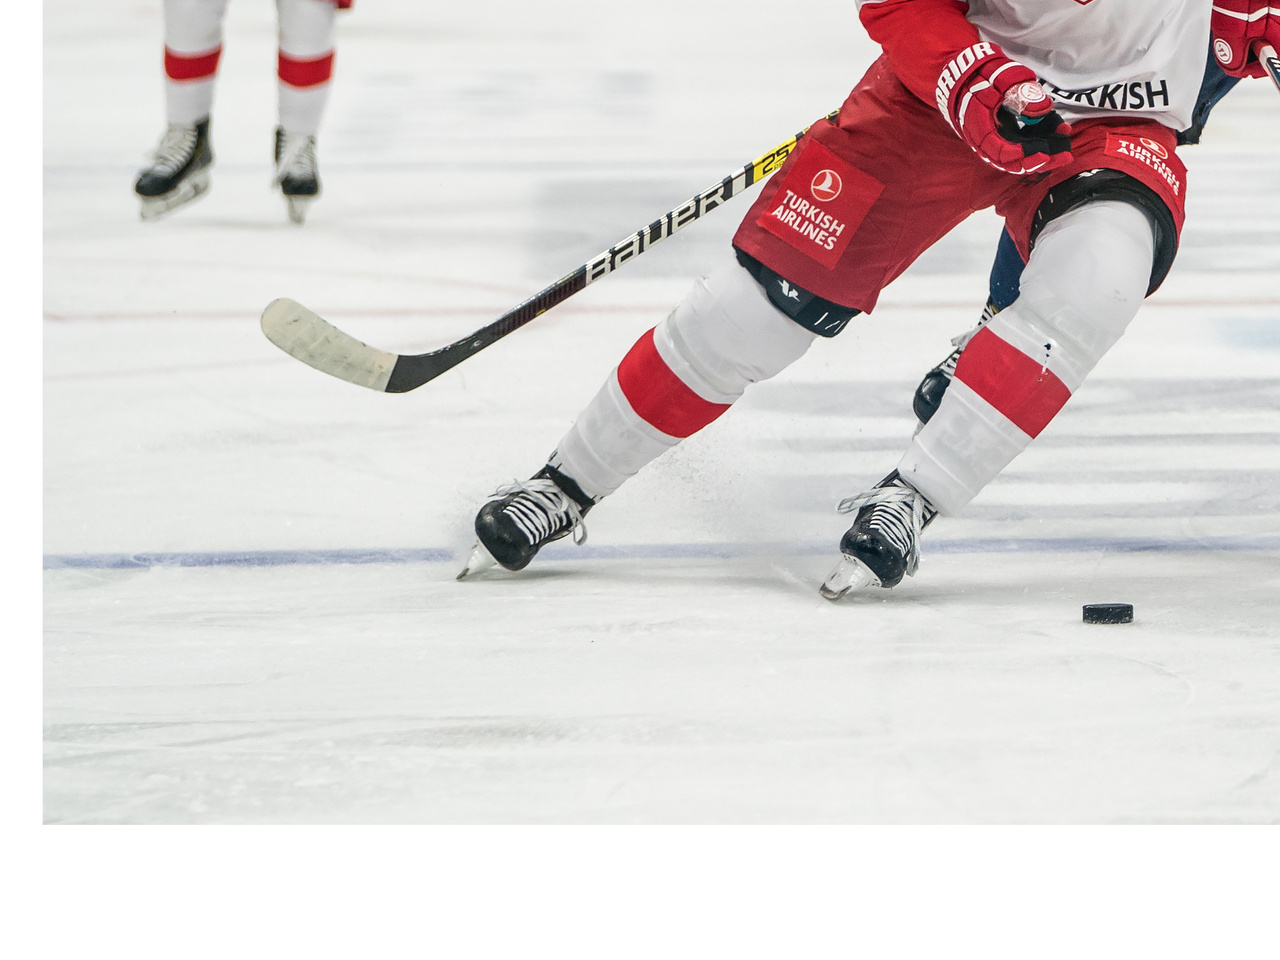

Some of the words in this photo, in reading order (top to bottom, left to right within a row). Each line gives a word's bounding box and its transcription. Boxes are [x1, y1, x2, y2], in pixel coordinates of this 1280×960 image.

[761, 143, 790, 176] 25
[1116, 147, 1180, 196] AIRLINES
[1118, 140, 1180, 187] TURKISH
[771, 204, 838, 250] AIRLINES
[782, 189, 846, 237] TURKISH
